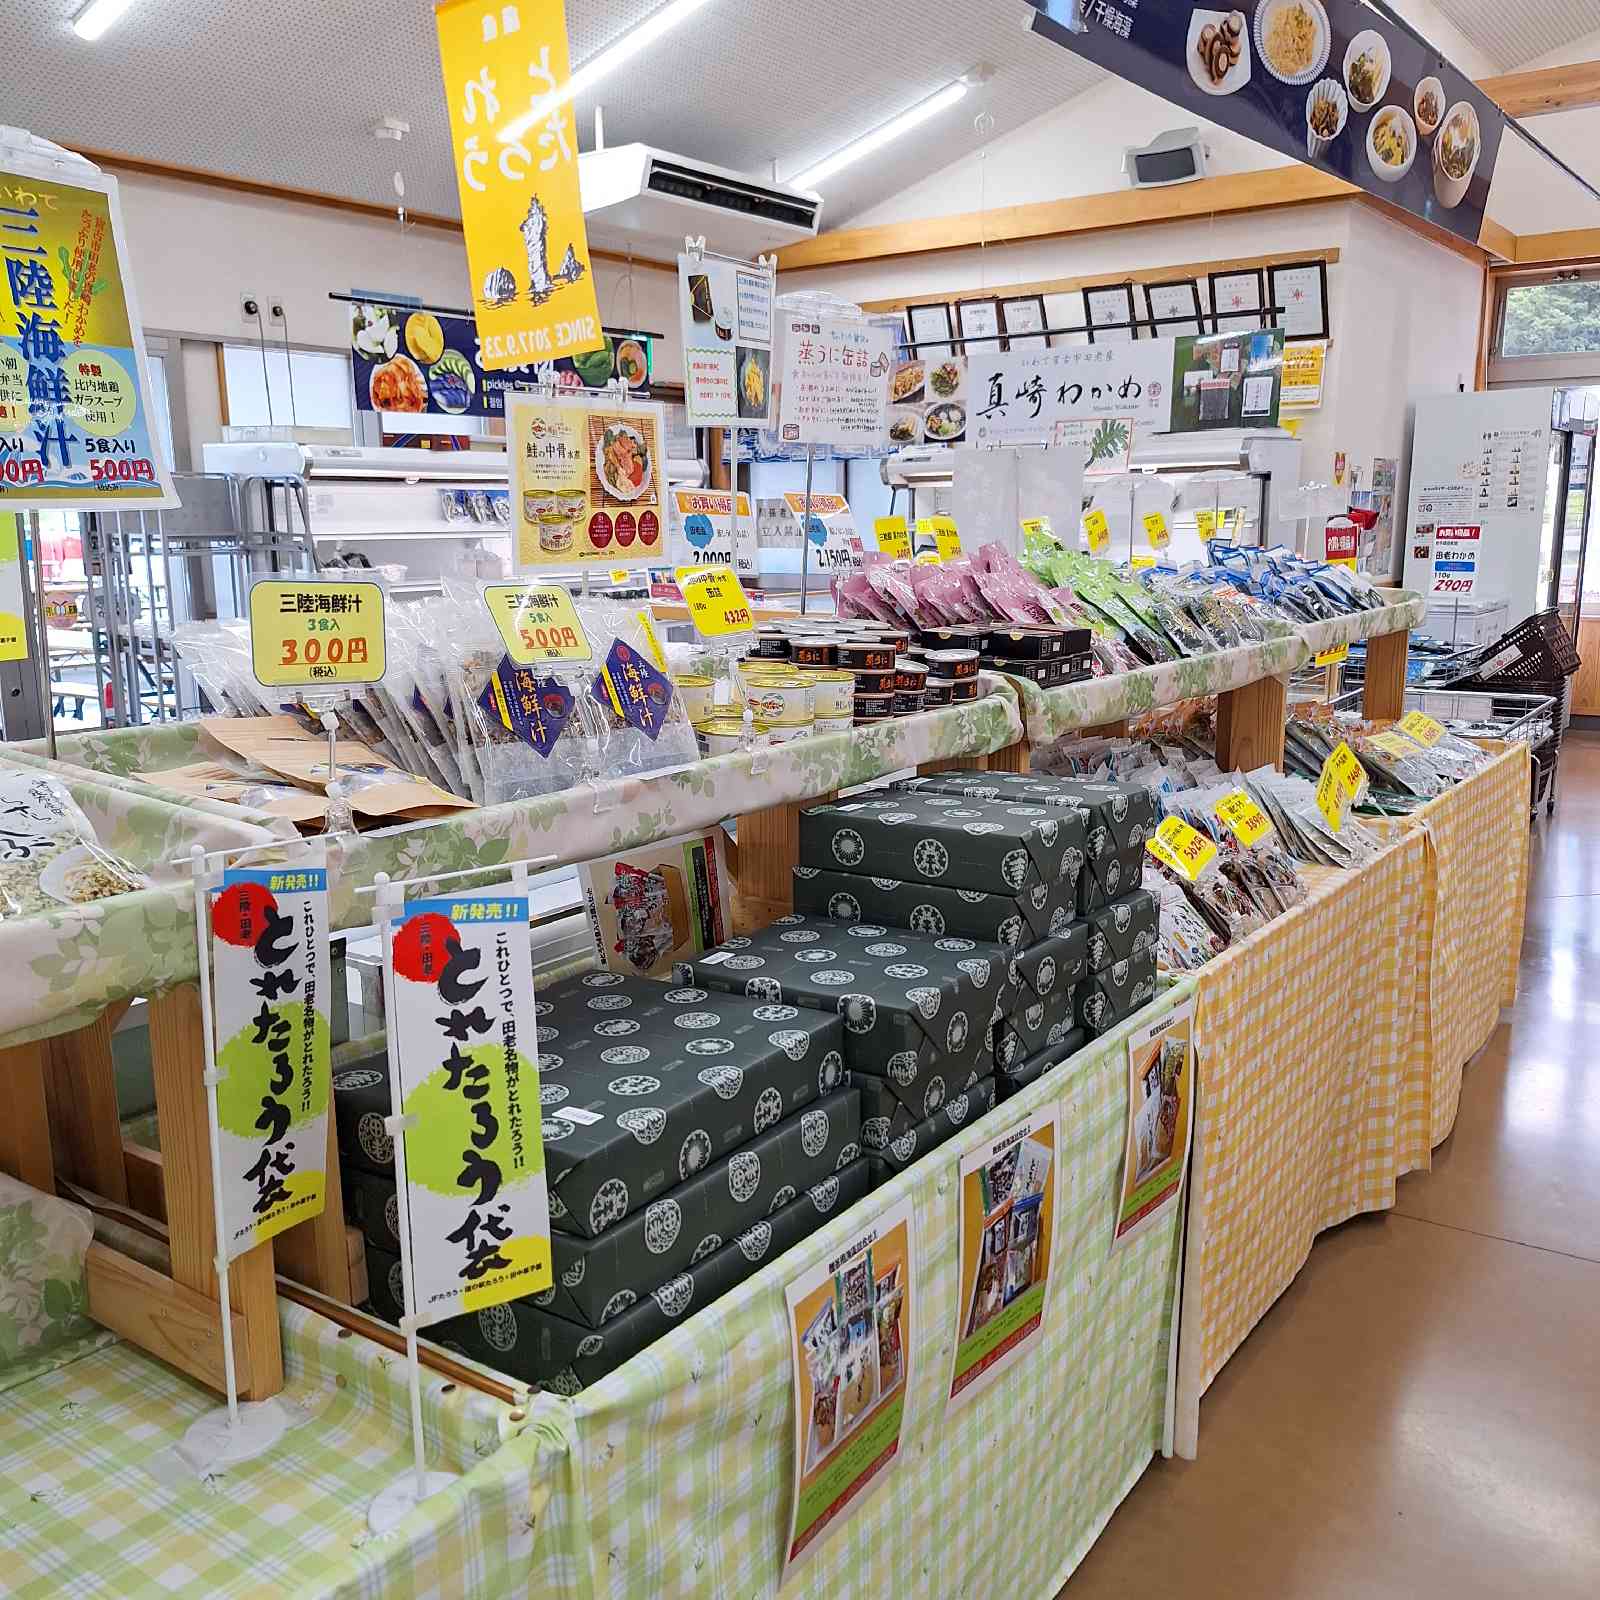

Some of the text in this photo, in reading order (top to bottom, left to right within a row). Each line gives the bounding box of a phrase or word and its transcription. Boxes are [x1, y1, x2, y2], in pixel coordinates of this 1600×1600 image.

[74, 379, 120, 394] 比内地鶏
[976, 372, 1142, 420] 真崎わかめ
[85, 438, 136, 454] 5食入り
[89, 458, 156, 482] 500円
[1433, 579, 1474, 593] 290円
[279, 593, 363, 613] 三陸海鮮汁
[307, 618, 341, 631] 3食入
[724, 608, 750, 625] 432円
[518, 626, 580, 649] 500円
[281, 637, 368, 665] 300円
[309, 666, 338, 678] (税込)
[621, 662, 654, 729] 海鮮汁
[270, 873, 320, 891] 新発売!!
[450, 903, 520, 921] 新発売!!
[243, 904, 302, 1214] とれたろう袋
[496, 931, 526, 1170] これひとつで、田老名物がとれたろう!!
[436, 938, 513, 1281] とれたろう袋
